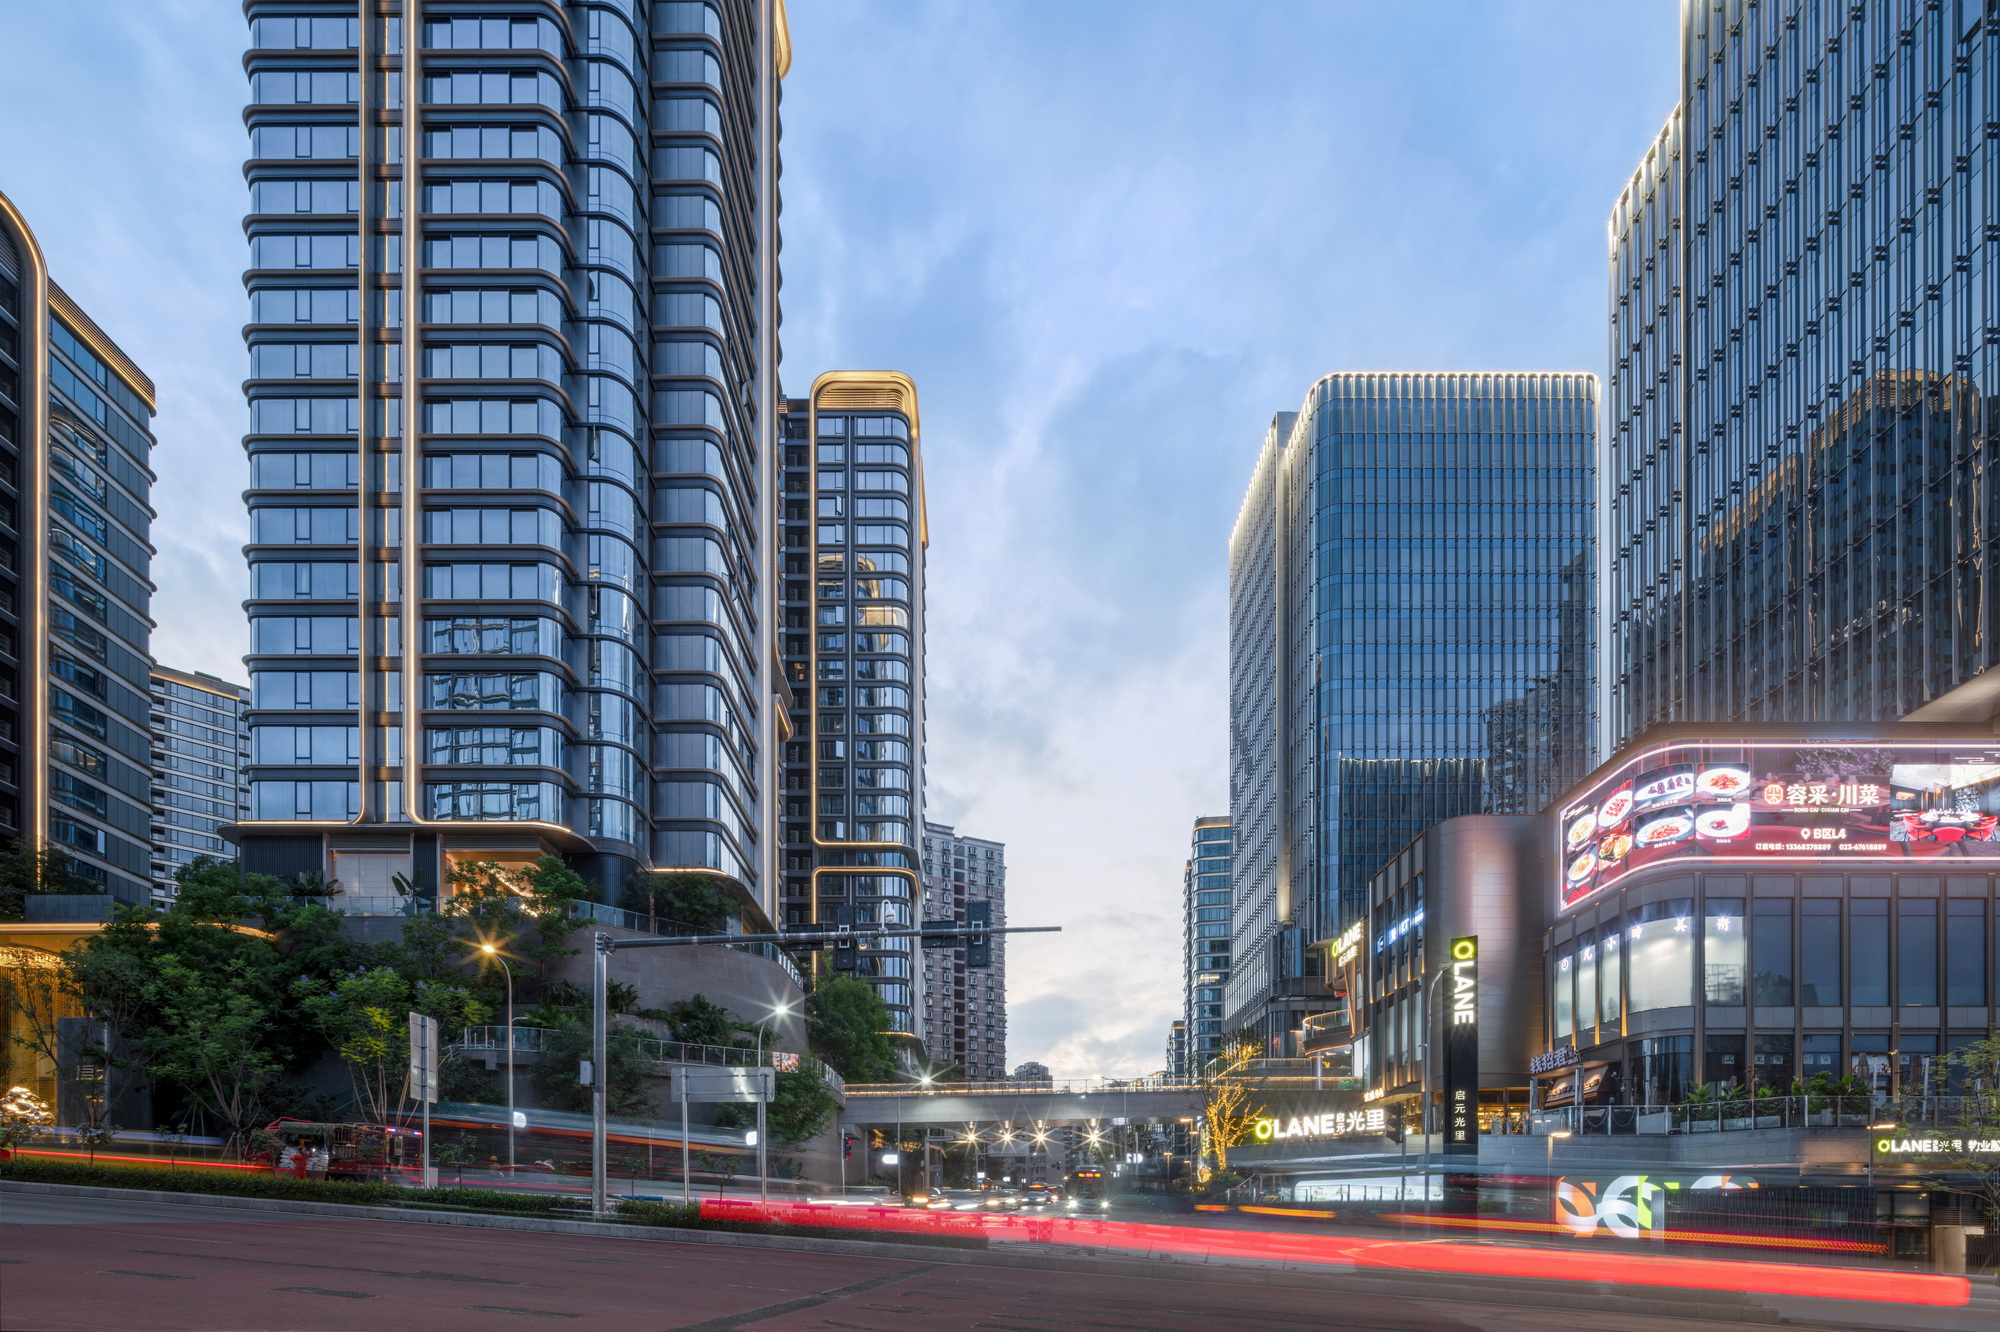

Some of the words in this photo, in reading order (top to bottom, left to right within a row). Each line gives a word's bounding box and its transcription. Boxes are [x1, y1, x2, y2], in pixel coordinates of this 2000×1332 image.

[1786, 784, 1880, 805] 容采·川菜
[1813, 828, 1847, 840] B区L4
[1454, 1090, 1466, 1141] 启元光里
